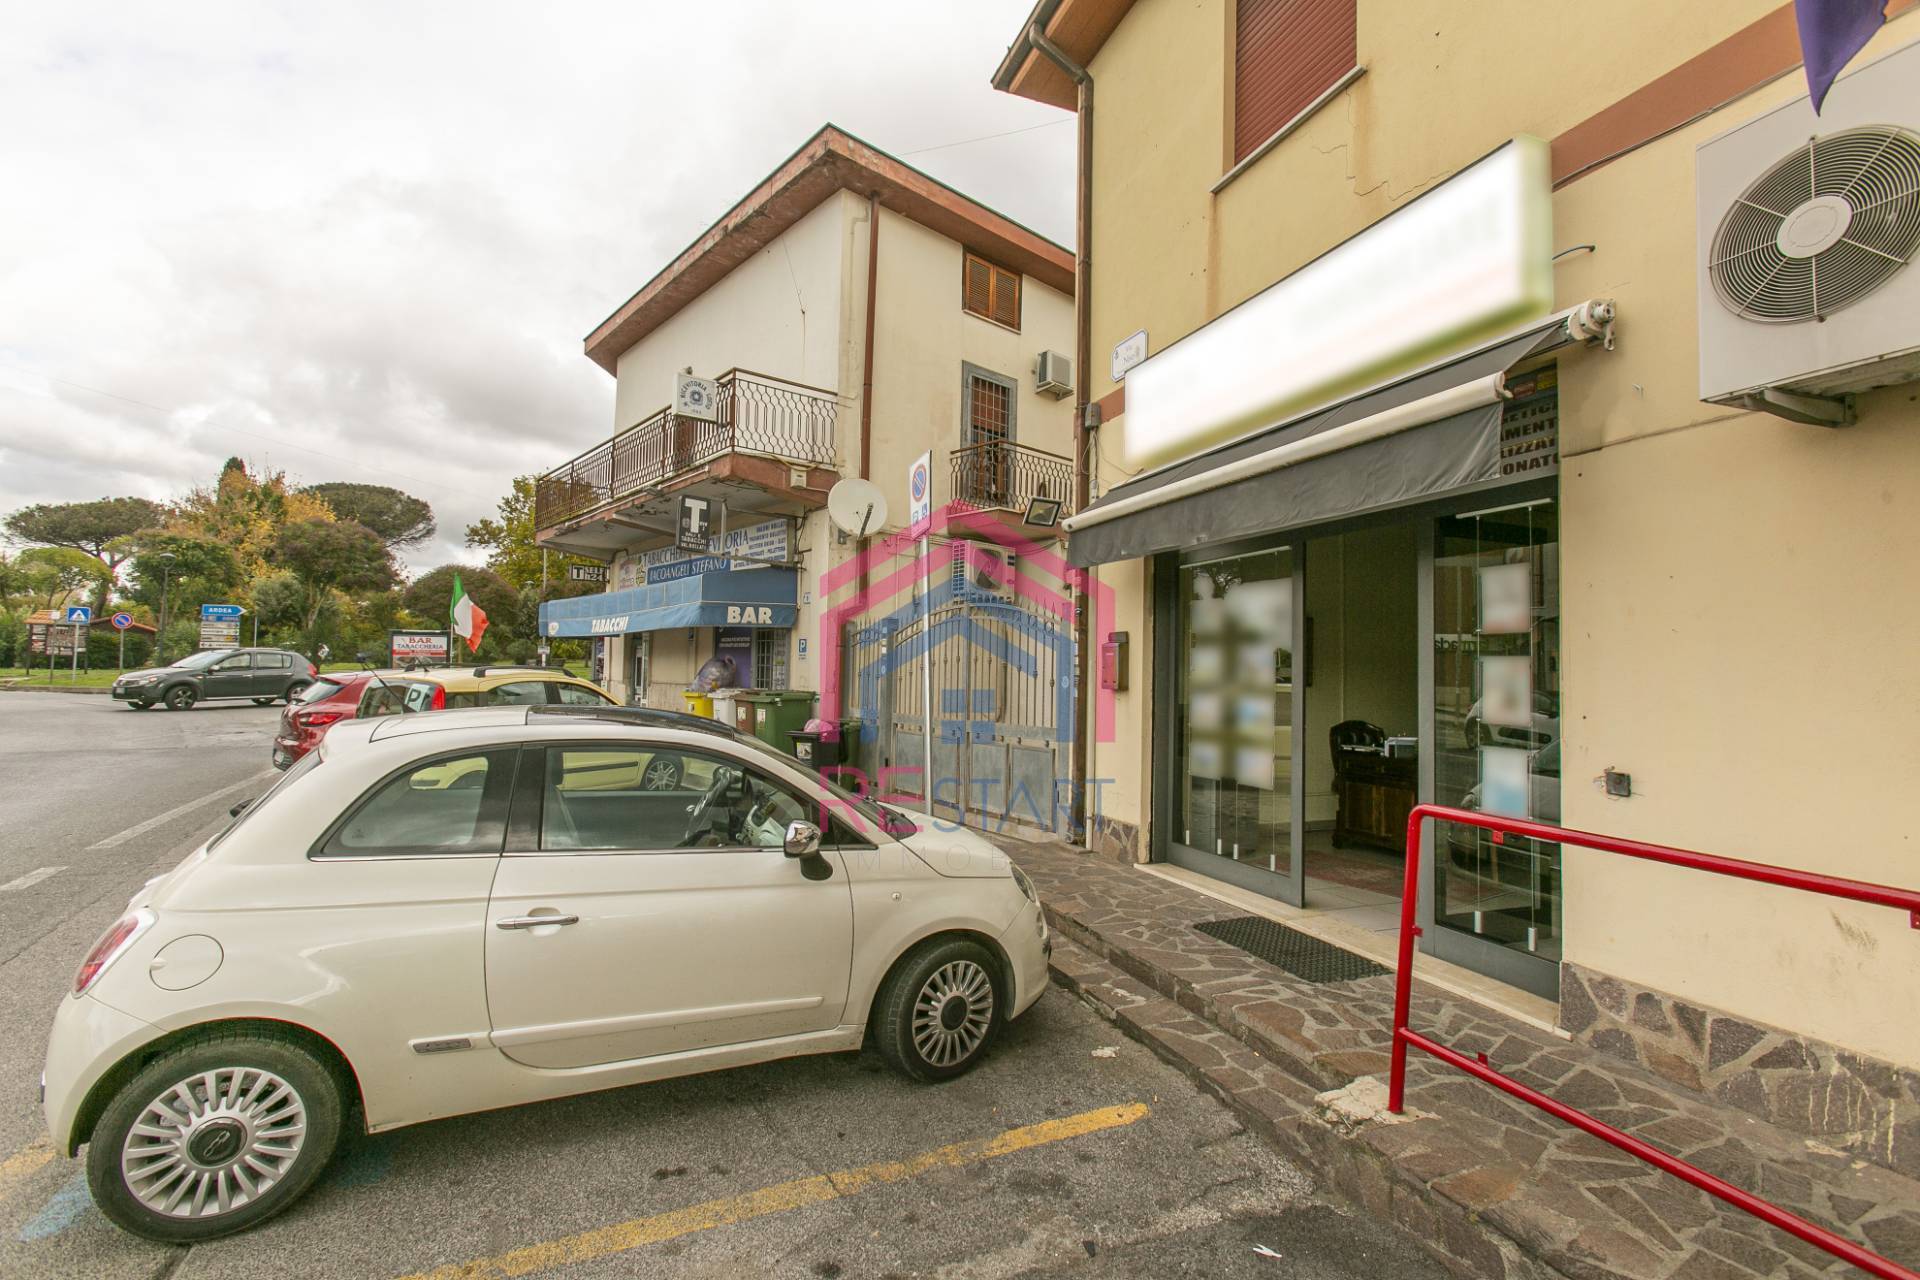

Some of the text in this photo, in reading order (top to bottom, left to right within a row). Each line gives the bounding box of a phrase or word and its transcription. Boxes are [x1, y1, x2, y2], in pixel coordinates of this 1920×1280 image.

[684, 498, 707, 533] T
[681, 535, 707, 545] TABACCHI
[574, 567, 584, 579] T
[727, 606, 773, 624] BAR
[592, 616, 630, 633] TABACCHI
